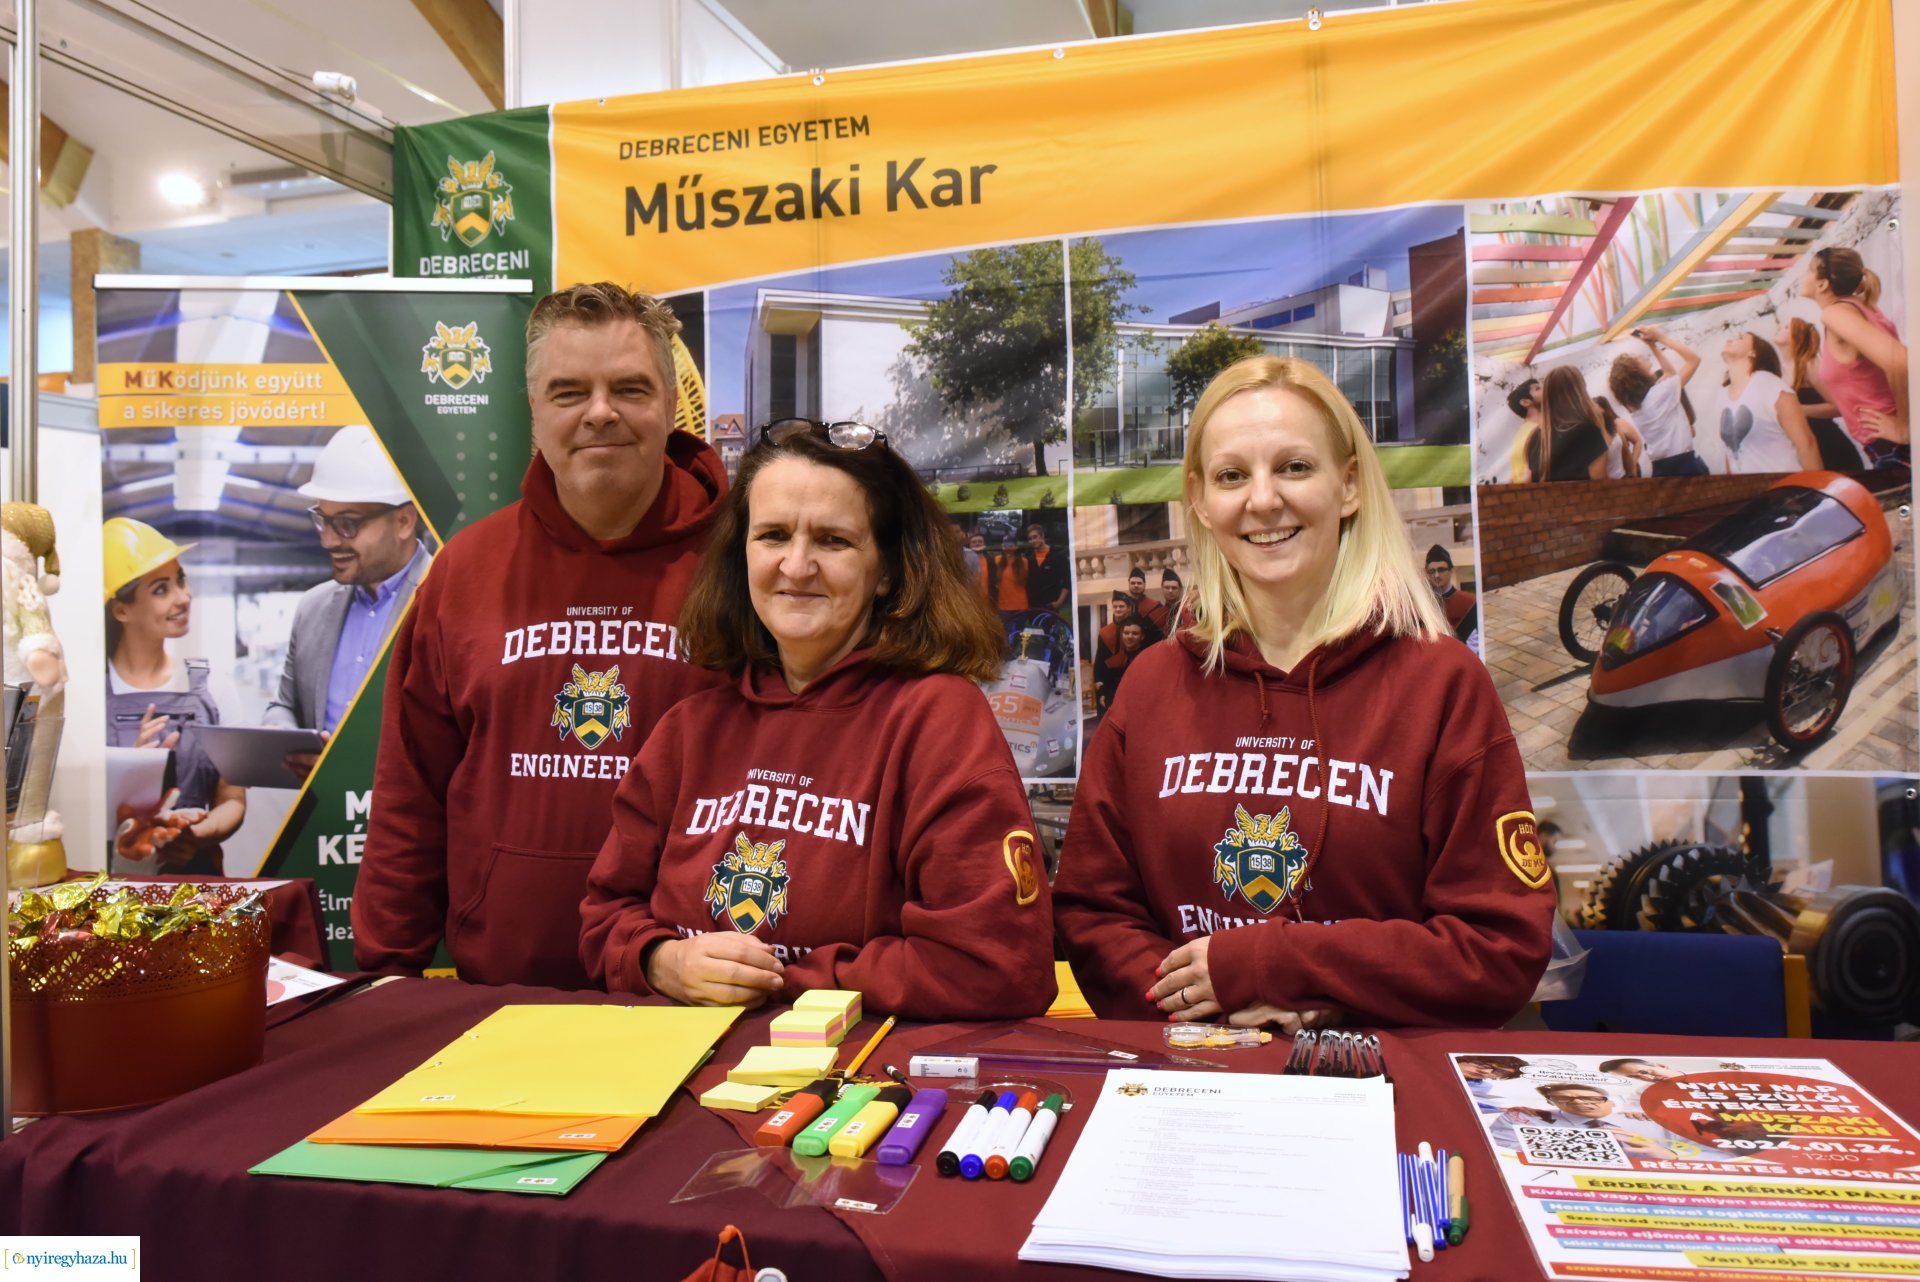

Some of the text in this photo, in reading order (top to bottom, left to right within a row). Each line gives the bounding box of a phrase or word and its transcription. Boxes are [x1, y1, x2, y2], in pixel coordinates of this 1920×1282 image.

[619, 114, 870, 160] DEBRECENI EGYETEM
[625, 157, 998, 236] Műszaki Kar
[419, 249, 529, 276] DEBRECENI
[124, 370, 323, 393] MűKödjünk együtt
[424, 393, 489, 406] DEBRECENI
[123, 400, 326, 423] a sikeres jövődért!
[437, 405, 477, 415] EGYETEM
[566, 606, 634, 616] UNIVERSITY OF
[1235, 736, 1315, 750] UNIVERSITY OF
[511, 753, 632, 780] ENGINEER
[799, 775, 814, 788] OF
[1158, 752, 1394, 816] DEBRECEN
[1153, 1086, 1222, 1095] DEBRECENI
[1675, 1081, 1838, 1094] NYÍLT NAP
[1688, 1090, 1853, 1104] ÉS SZÜLŐI
[1661, 1098, 1860, 1115] ÉRTEKEZLET
[1689, 1111, 1880, 1127] A MŰSZAKI
[1761, 1123, 1892, 1137] KARON
[1713, 1138, 1916, 1156] 2024.01.24.
[1801, 1152, 1860, 1163] 12:00
[1641, 1160, 1788, 1176] RÉSZLETES
[1588, 1179, 1696, 1192] ÉRDEKEL
[1702, 1184, 1718, 1192] A
[1724, 1185, 1839, 1198] MÉRNÖKI
[1599, 1192, 1642, 1201] vagy,
[1645, 1194, 1686, 1204] hogy
[1550, 1203, 1590, 1211] Nem
[1594, 1205, 1648, 1214] tudod
[1653, 1208, 1703, 1216] mivel
[1707, 1209, 1811, 1221] foglalkozik
[1816, 1214, 1851, 1223] egy
[1566, 1214, 1649, 1225] Szeretnéd
[1744, 1223, 1787, 1232] hogy
[1791, 1225, 1837, 1234] lehet
[1554, 1227, 1628, 1238] Szívesen
[1632, 1231, 1701, 1242] eljönnél
[1720, 1234, 1791, 1245] felvételi
[1702, 1255, 1741, 1264] Van
[1814, 1261, 1851, 1269] egy
